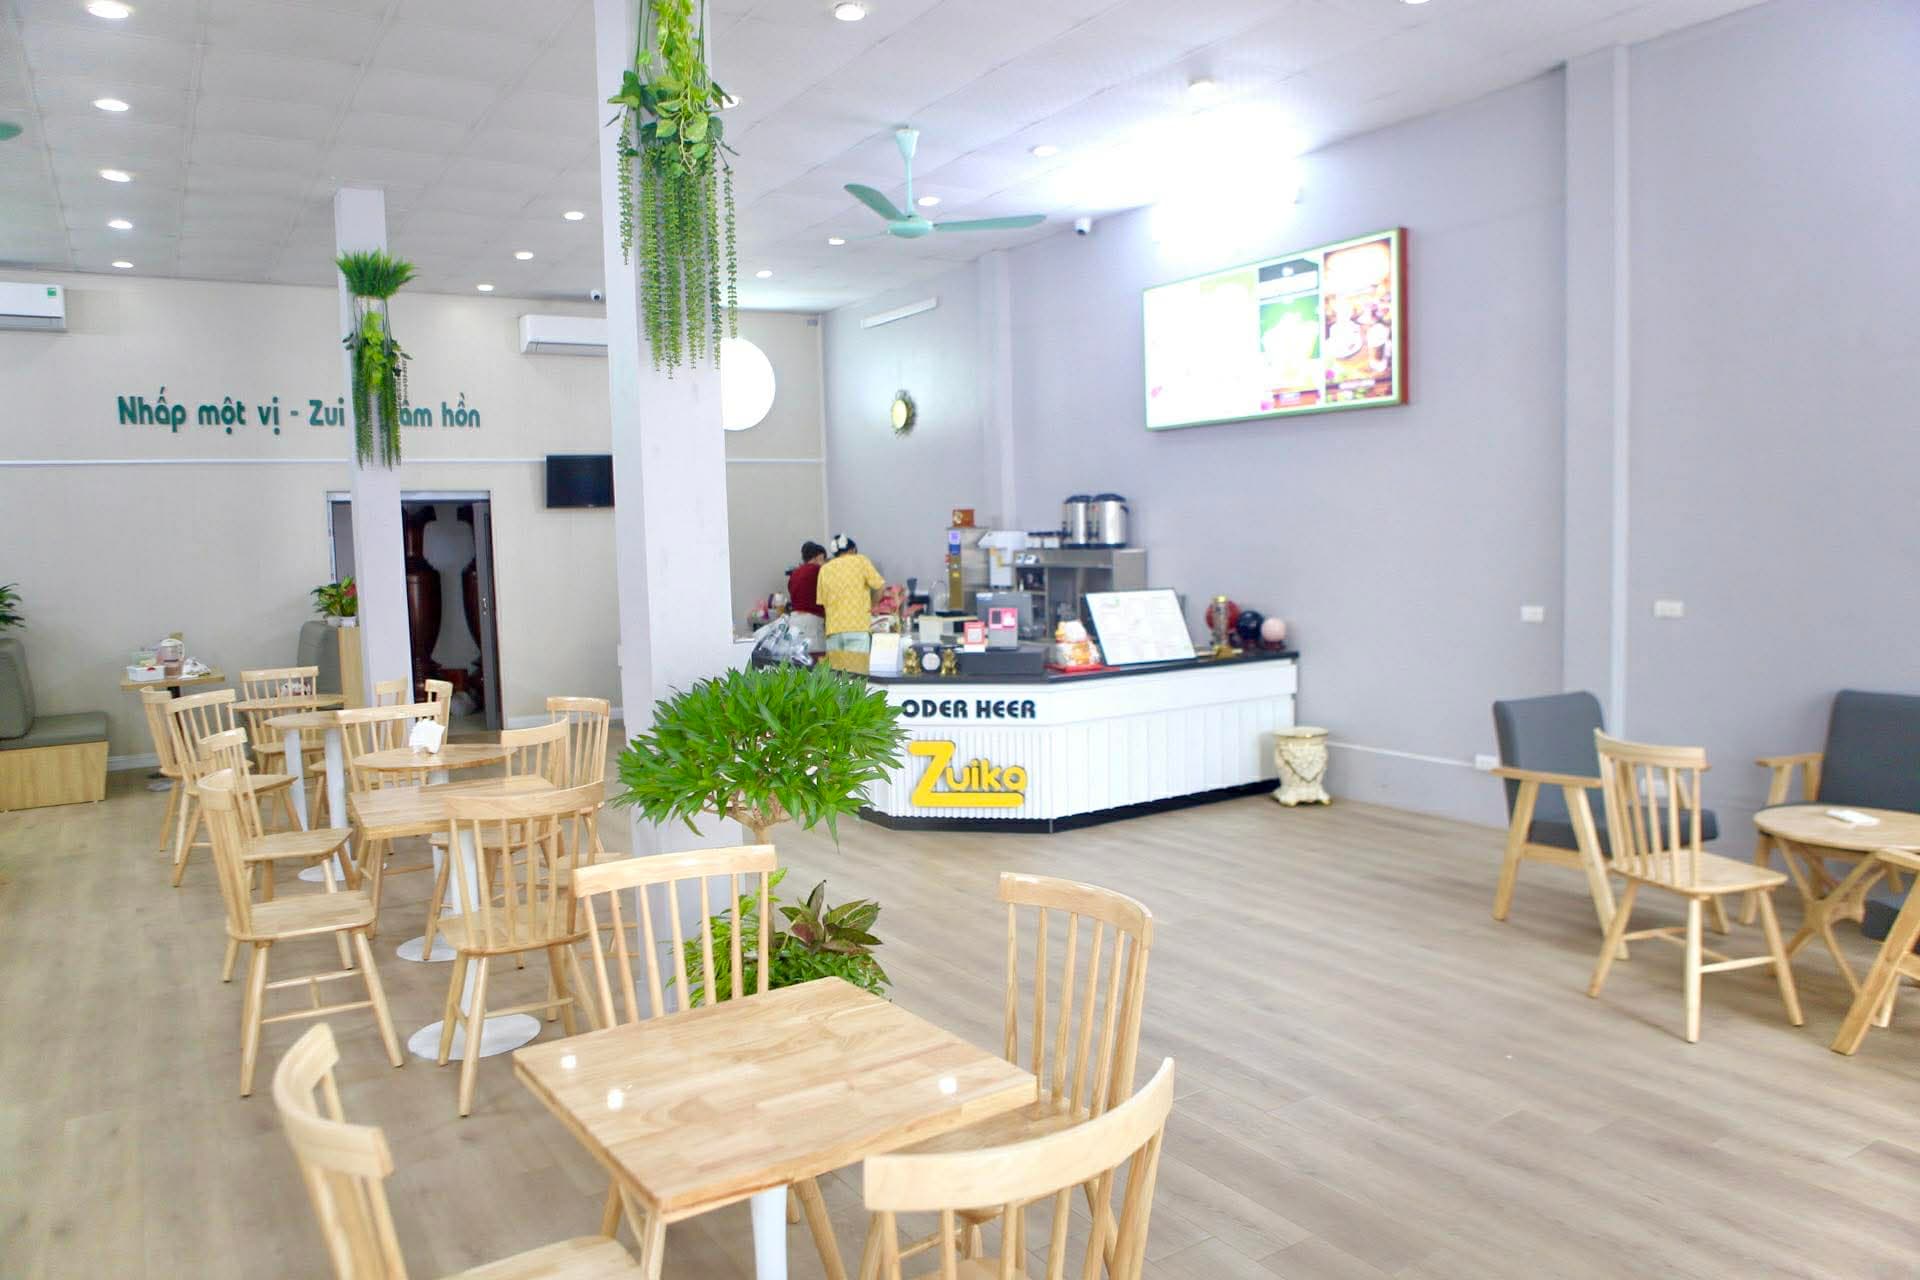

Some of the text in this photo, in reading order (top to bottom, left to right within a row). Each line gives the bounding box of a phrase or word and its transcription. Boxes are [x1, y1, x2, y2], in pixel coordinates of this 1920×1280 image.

[118, 386, 187, 433] Nhấp
[198, 396, 246, 434] một
[257, 396, 281, 435] vị
[399, 399, 433, 427] âm
[441, 392, 480, 427] hồn
[901, 699, 1036, 718] ODER HEER
